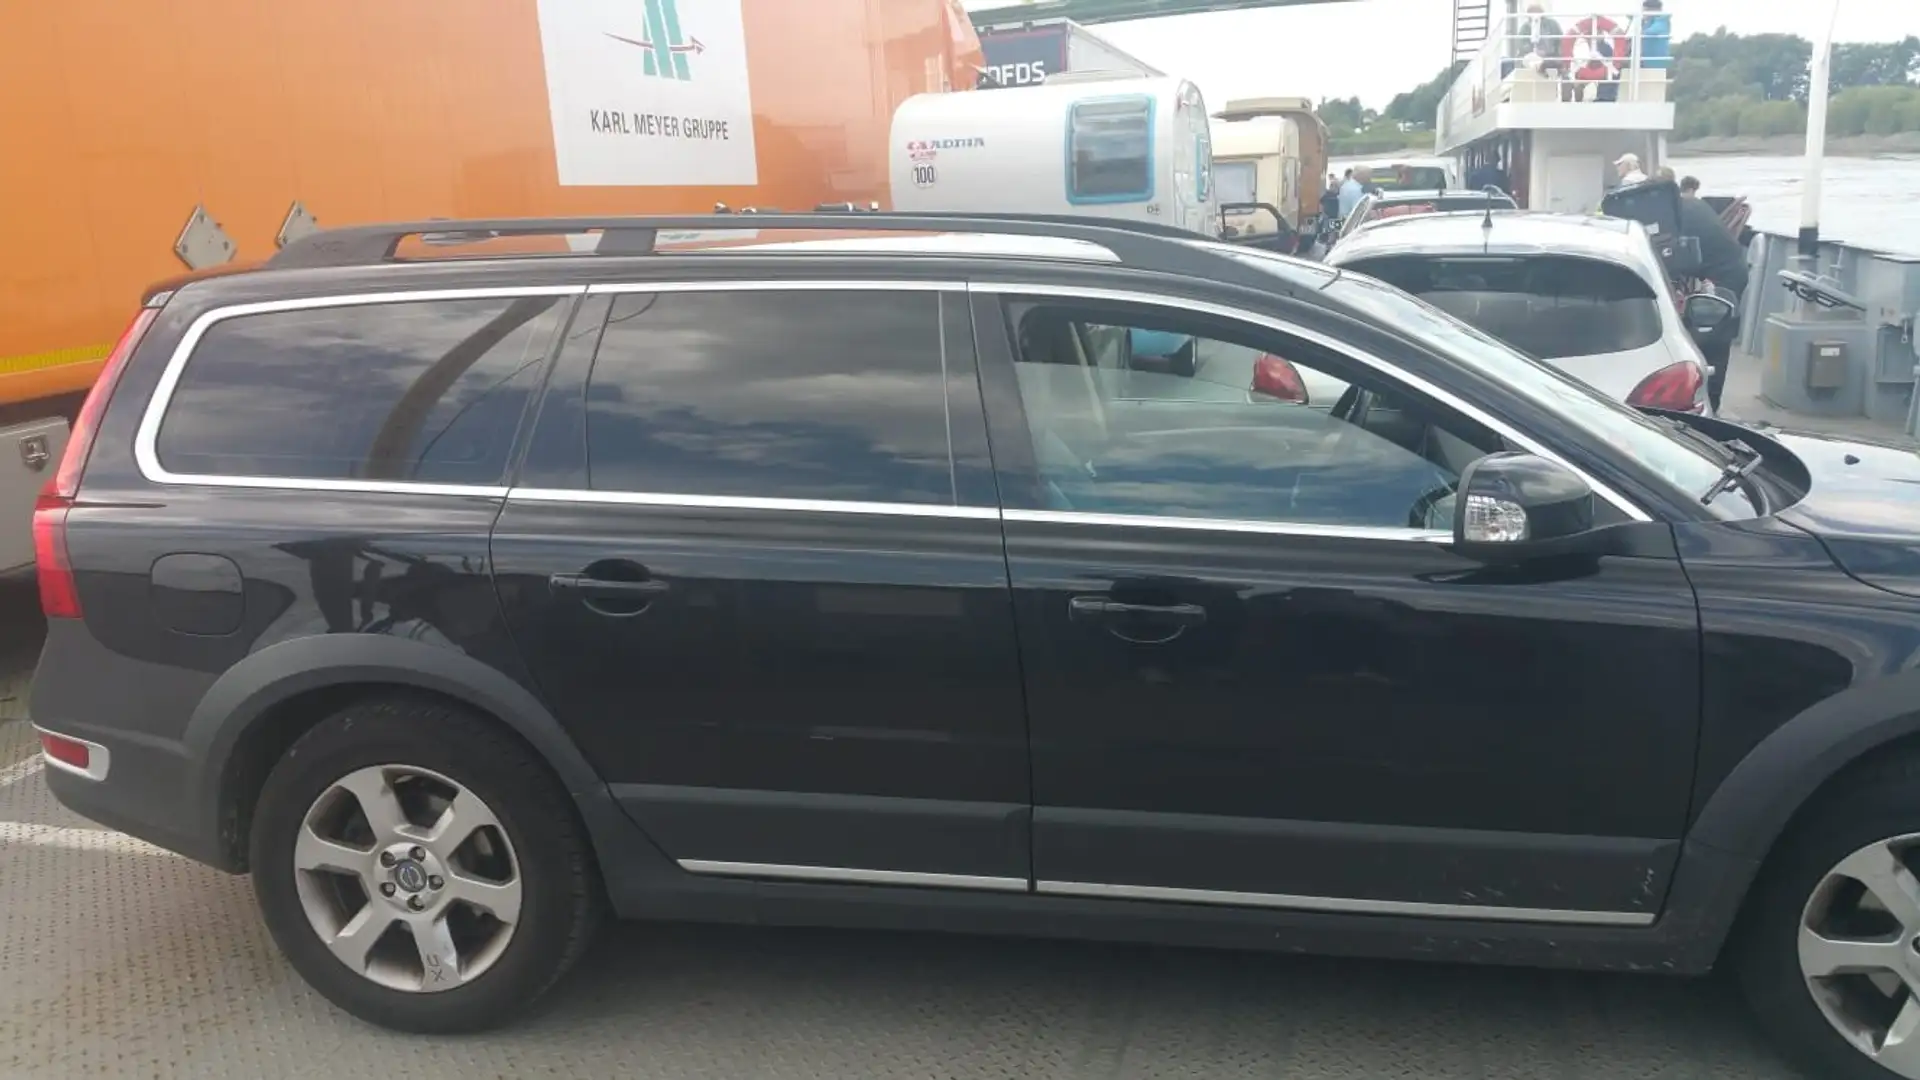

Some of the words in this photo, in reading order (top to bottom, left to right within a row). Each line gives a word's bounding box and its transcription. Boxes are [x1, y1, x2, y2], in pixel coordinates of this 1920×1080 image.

[590, 109, 630, 134] KARL
[633, 113, 680, 137] MEYER
[682, 117, 729, 140] GRUPPE
[914, 165, 935, 184] 100
